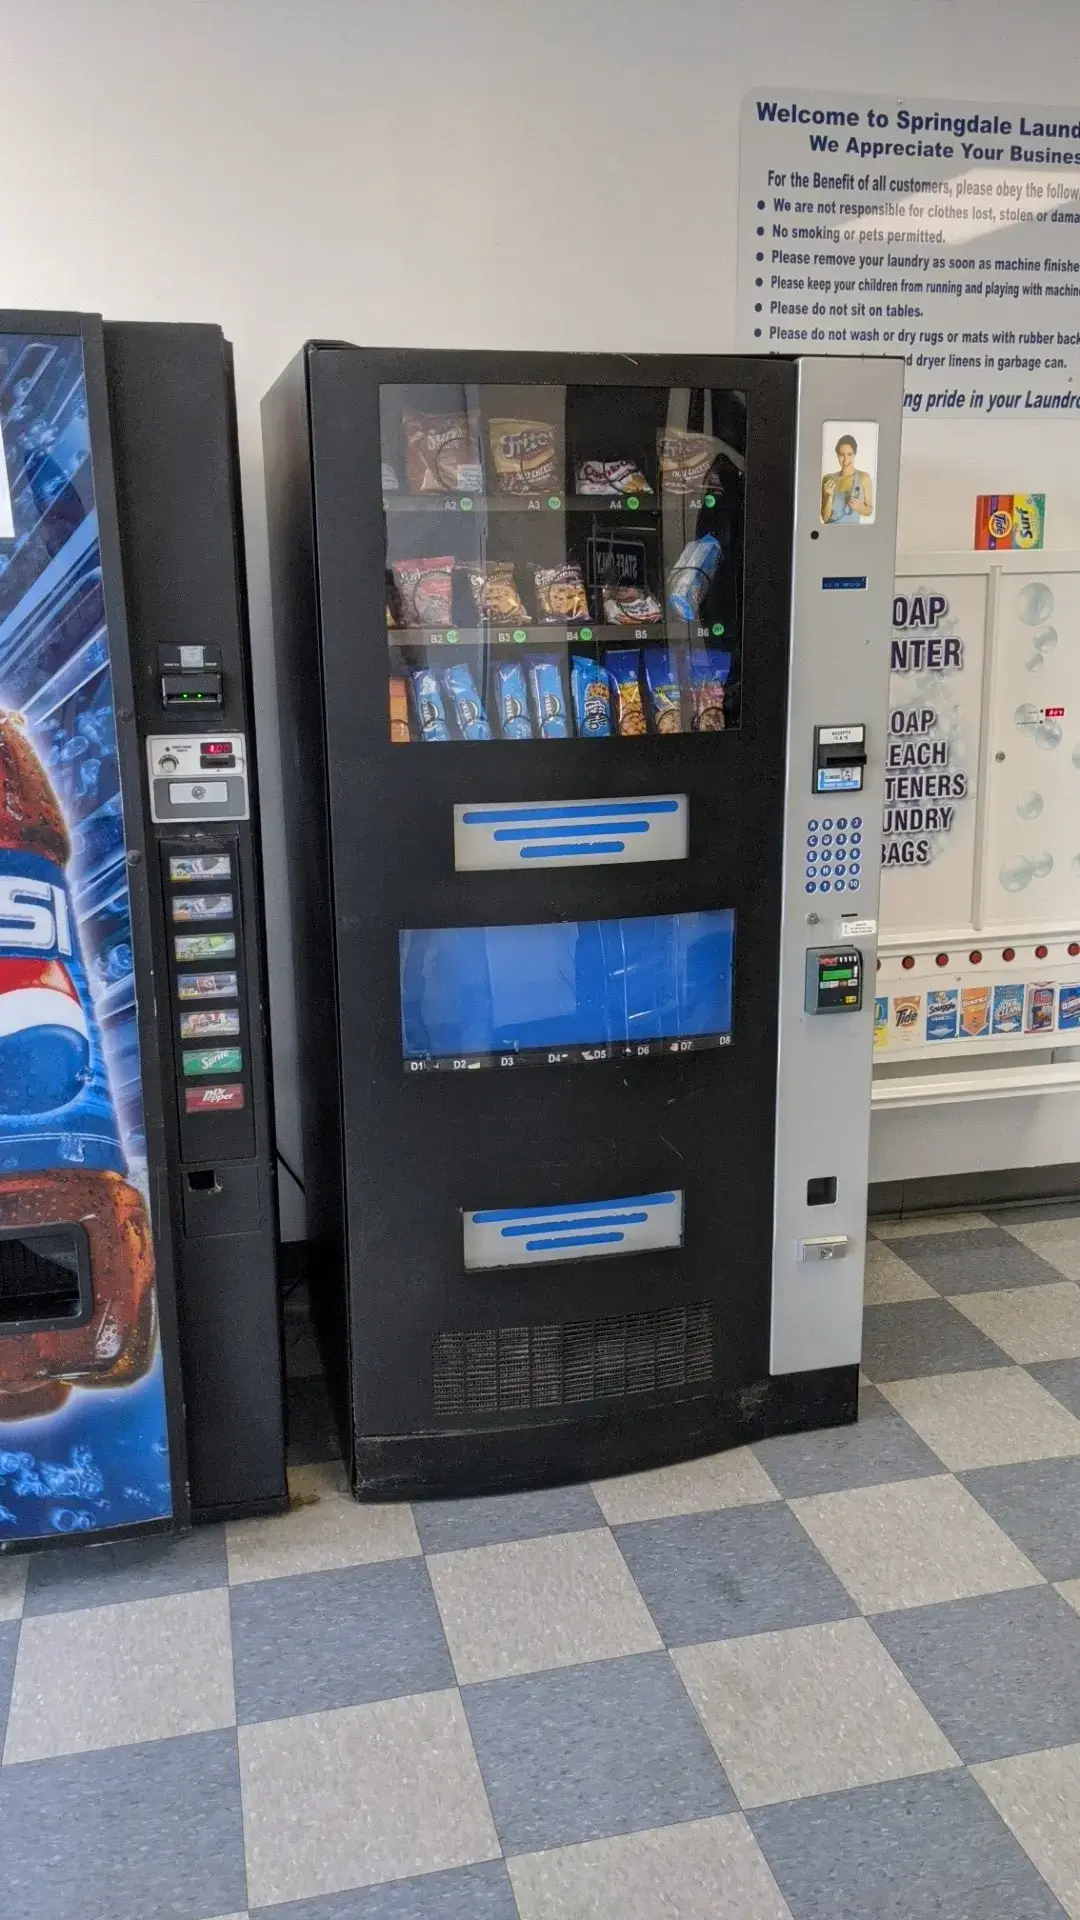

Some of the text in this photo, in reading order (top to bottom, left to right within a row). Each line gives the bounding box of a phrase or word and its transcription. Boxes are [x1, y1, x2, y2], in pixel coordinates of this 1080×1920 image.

[756, 102, 859, 124] Welcome
[866, 109, 889, 126] to
[896, 111, 1012, 135] Springdale
[810, 135, 839, 153] We
[846, 137, 954, 158] Appreciate
[961, 142, 1004, 160] Your
[768, 170, 1080, 201] For the Benefit of all customers, please obey the follow
[774, 198, 791, 212] We
[795, 202, 814, 213] are
[817, 200, 836, 216] not
[840, 202, 905, 218] responsible
[909, 204, 924, 218] for
[928, 204, 968, 219] clothes
[972, 206, 995, 222] lost,
[1000, 208, 1033, 221] stolen
[1036, 212, 1048, 222] or
[772, 224, 945, 245] No smoking or pets permitted.
[772, 249, 1080, 272] Please remove your laundry as soon as machine finishe
[771, 275, 1080, 298] Please keep your children from running and playing with machin
[770, 301, 923, 319] Please do not sit on tables.
[769, 326, 808, 340] Please
[811, 327, 825, 340] do
[828, 328, 847, 341] not
[850, 328, 879, 341] wash
[883, 331, 895, 341] or
[898, 329, 916, 345] dry
[918, 332, 944, 345] rugs
[947, 332, 960, 343] or
[962, 331, 989, 344] mats
[992, 331, 1015, 344] with
[1019, 331, 1054, 344] rubber
[906, 353, 913, 366] d
[916, 353, 946, 370] dryer
[949, 354, 981, 367] linens
[985, 354, 994, 368] in
[997, 355, 1041, 371] garbage
[1044, 358, 1067, 368] can.
[904, 389, 923, 412] ng
[925, 390, 965, 412] pride
[969, 391, 984, 408] in
[986, 394, 1022, 412] your
[444, 501, 457, 510] A2
[528, 501, 541, 510] A3
[610, 500, 622, 509] A4
[690, 500, 702, 509] A5
[1016, 506, 1033, 539] Surf
[893, 596, 946, 627] OAP
[430, 634, 444, 644] B2
[498, 633, 511, 642] B3
[566, 632, 579, 641] B4
[635, 630, 648, 639] B5
[697, 628, 709, 637] B6
[891, 638, 961, 669] NTER
[891, 709, 935, 734] OAP
[890, 741, 947, 767] EACH
[885, 773, 966, 800] TENERS
[883, 806, 953, 833] UNDRY
[929, 1002, 956, 1015] Snuggle
[963, 995, 989, 1008] Bounce
[896, 1008, 918, 1028] Tide
[680, 1041, 692, 1051] D7
[719, 1036, 731, 1045] D8
[548, 1053, 560, 1063] D4
[594, 1050, 606, 1059] D5
[638, 1046, 650, 1056] D6
[201, 1050, 231, 1070] Sprite
[411, 1062, 423, 1071] D1
[454, 1060, 466, 1069] D2
[501, 1057, 514, 1066] D3
[201, 1090, 234, 1103] Pepper
